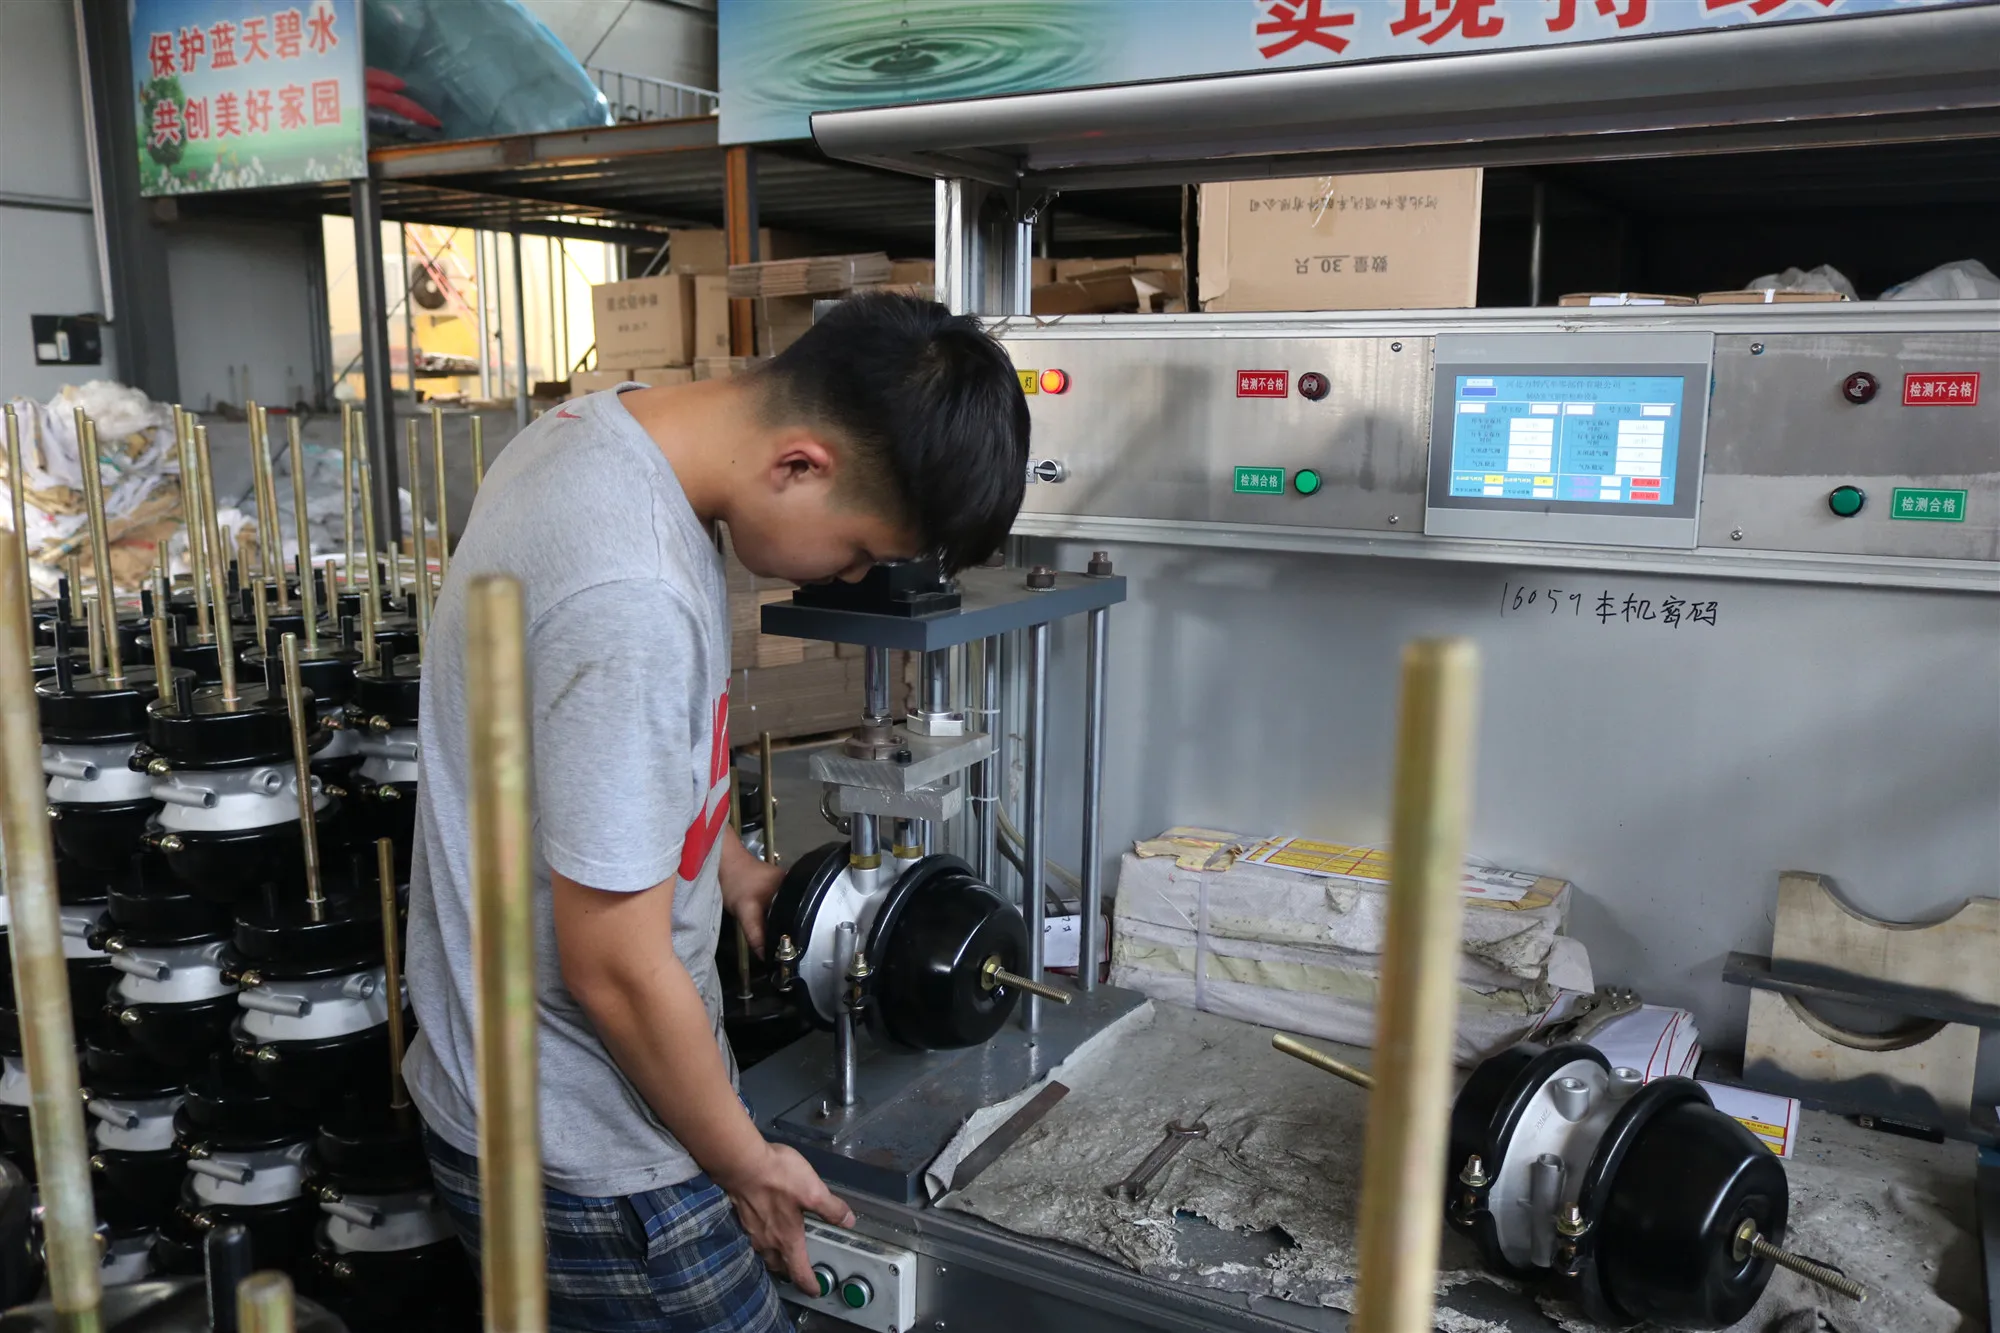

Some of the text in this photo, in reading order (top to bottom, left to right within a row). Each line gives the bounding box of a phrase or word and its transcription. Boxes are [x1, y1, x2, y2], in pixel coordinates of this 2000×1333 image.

[149, 6, 338, 78] 保护蓝天碧水
[154, 79, 341, 145] 共创美好家园
[1294, 255, 1388, 274] 数量 30 只
[1241, 377, 1284, 391] 检测不合格
[1909, 381, 1973, 398] 检测不合格
[1240, 473, 1278, 488] 检测合格
[1901, 496, 1956, 513] 检测合格
